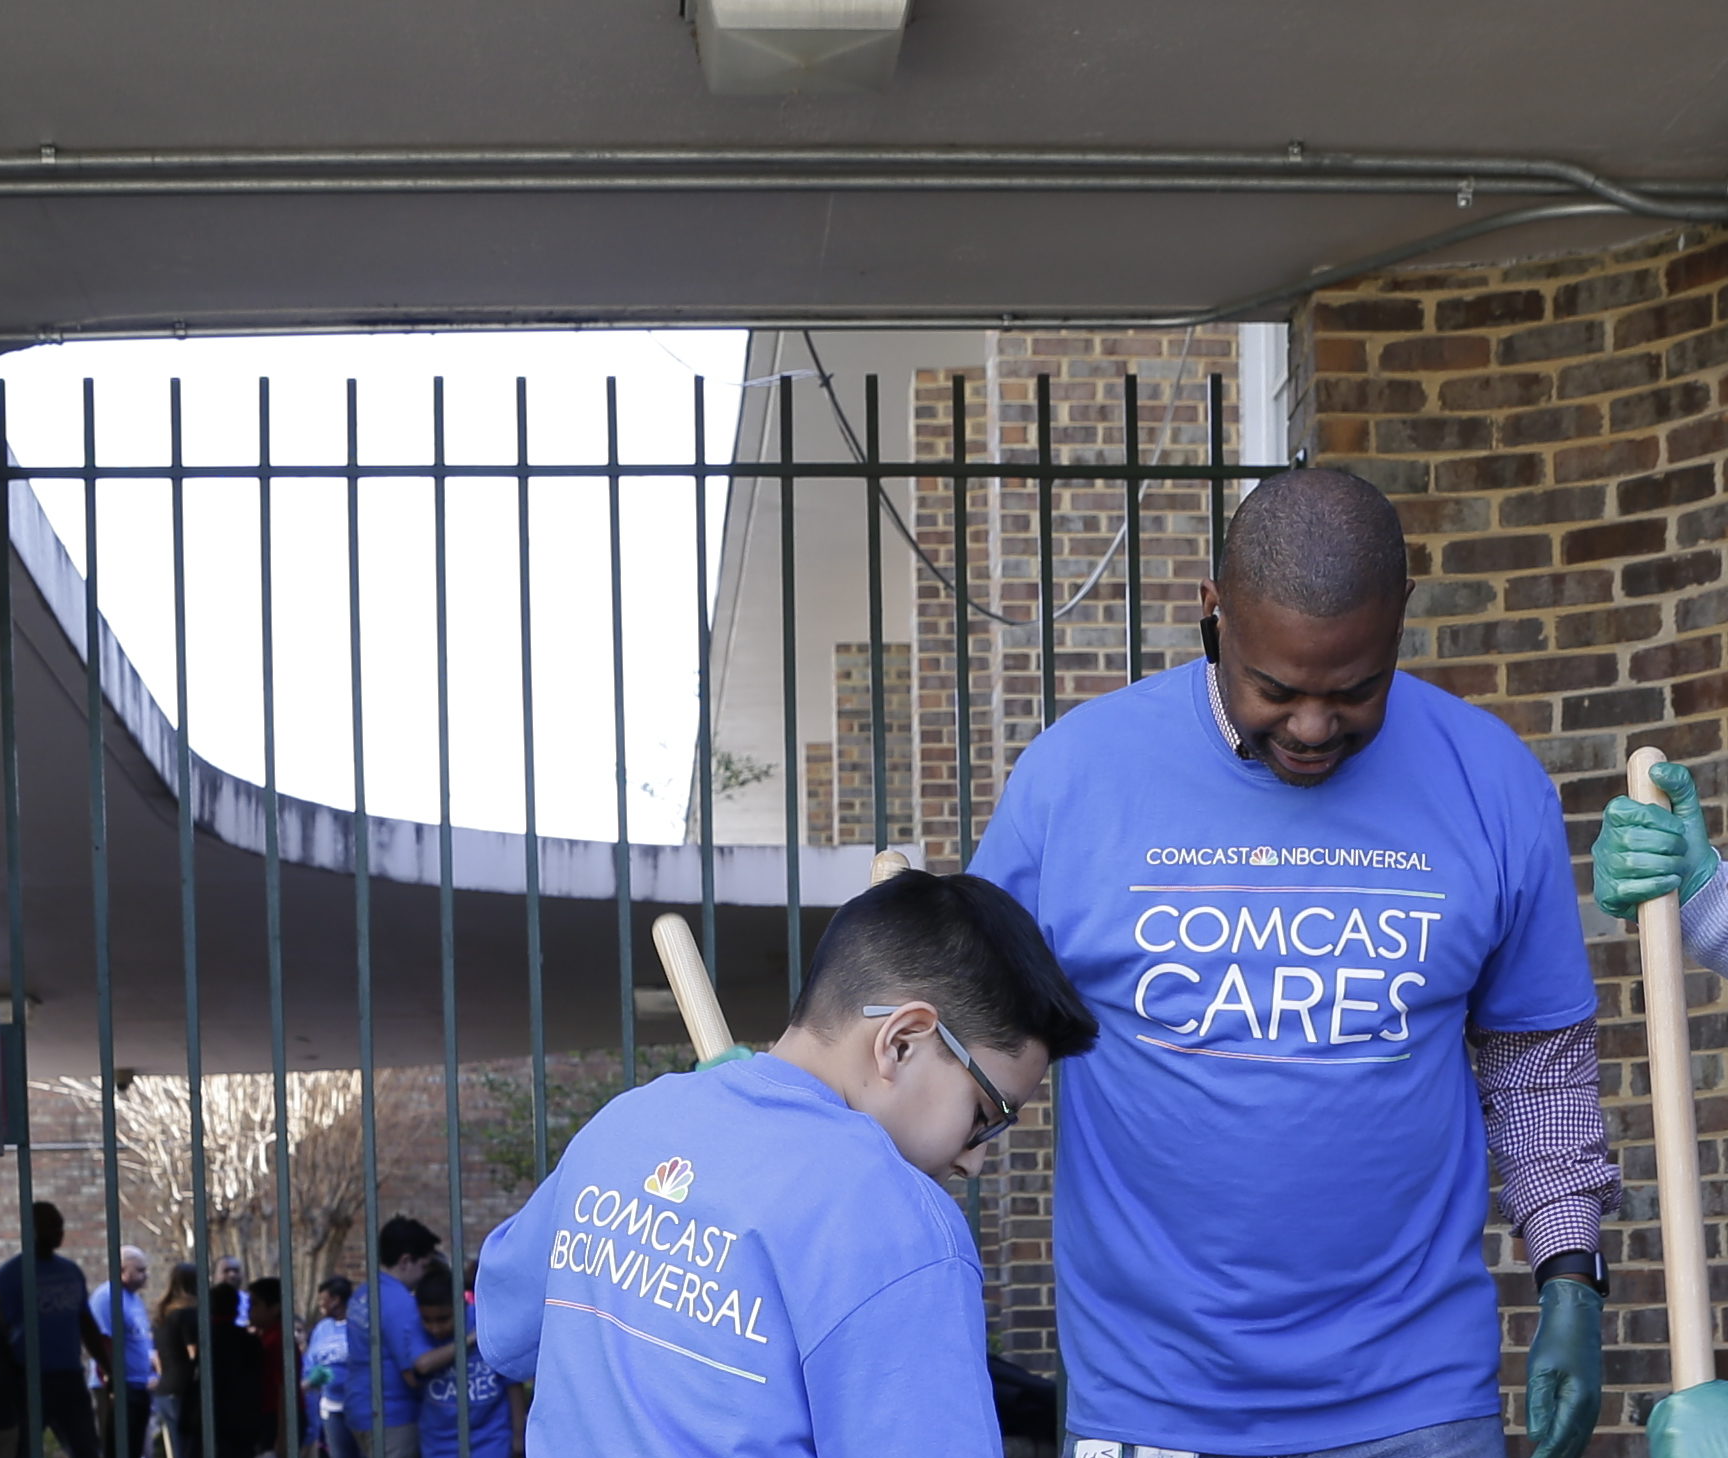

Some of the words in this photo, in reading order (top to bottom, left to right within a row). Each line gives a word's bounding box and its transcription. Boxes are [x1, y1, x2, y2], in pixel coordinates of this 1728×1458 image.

[1146, 846, 1251, 867] COMCAST
[1281, 847, 1432, 872] NBCUNIVERSAL
[1133, 904, 1442, 963] COMCAST
[1134, 962, 1426, 1045] CARES
[574, 1185, 738, 1273] COMCAST
[428, 1373, 499, 1401] CARES
